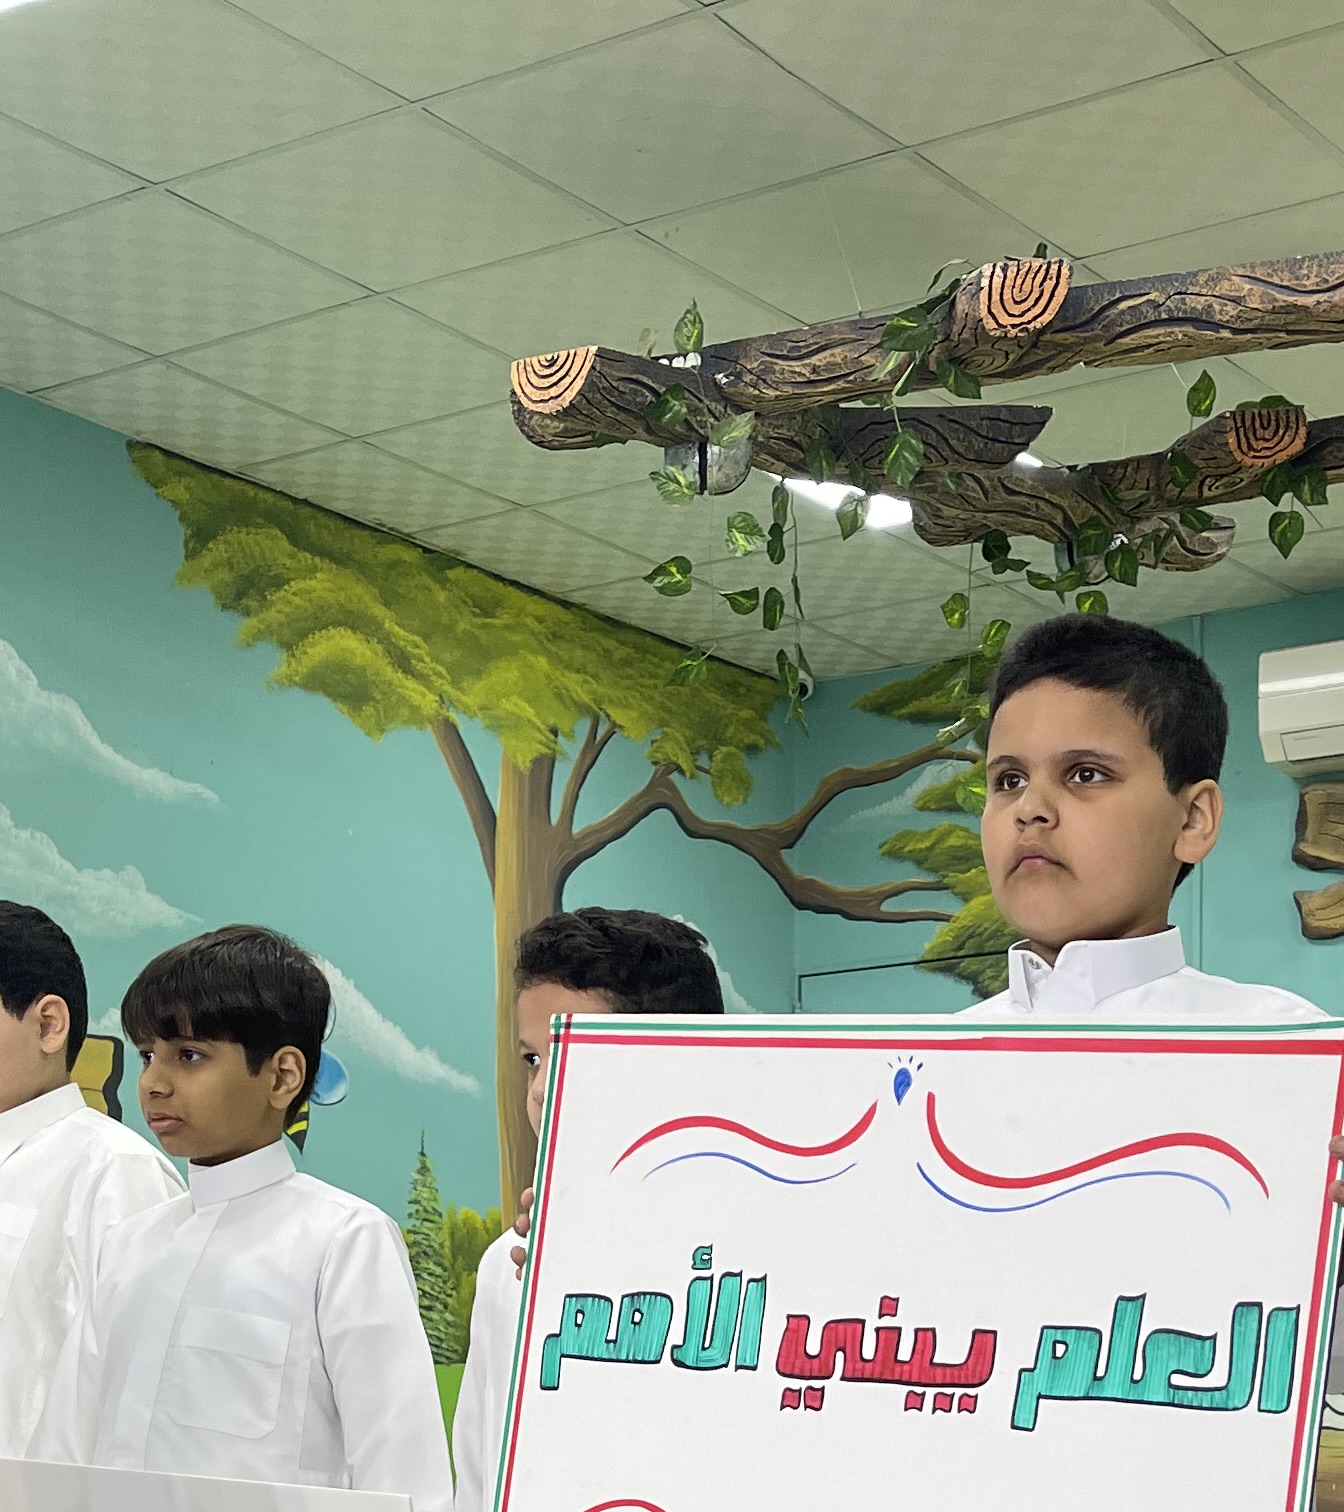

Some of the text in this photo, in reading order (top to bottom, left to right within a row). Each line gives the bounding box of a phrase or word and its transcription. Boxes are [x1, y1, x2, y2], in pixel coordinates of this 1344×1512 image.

[540, 1243, 1301, 1431] العلم يبني الأمم
